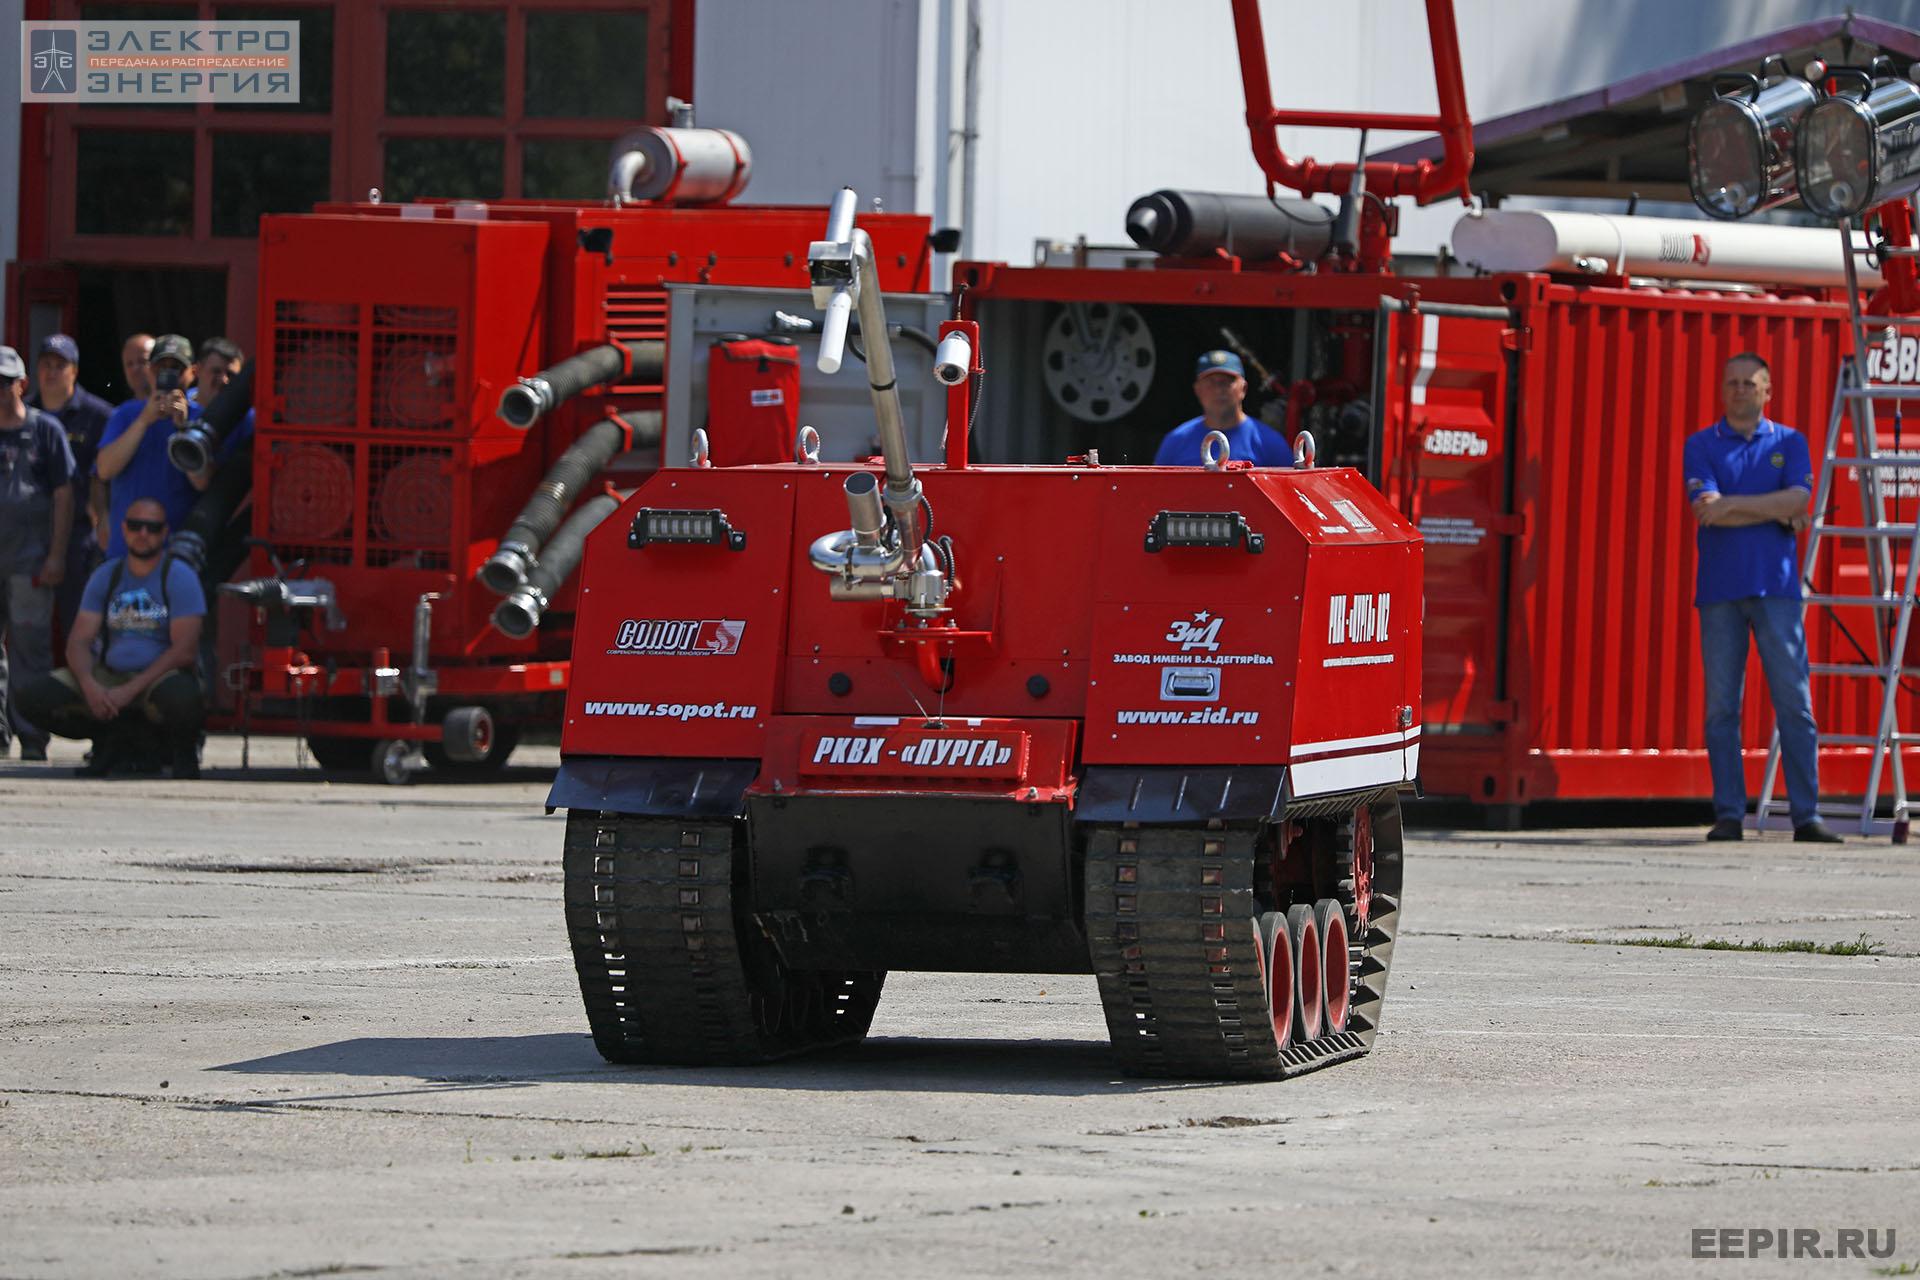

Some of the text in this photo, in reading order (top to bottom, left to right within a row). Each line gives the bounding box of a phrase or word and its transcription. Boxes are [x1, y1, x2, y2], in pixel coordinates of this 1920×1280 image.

[615, 619, 700, 650] СОПОТ
[1113, 654, 1151, 665] ЗАВОД
[1152, 655, 1192, 665] ИМЕНИ
[585, 701, 757, 721] www.sopot.ru
[1117, 706, 1259, 725] www.zid.ru
[813, 737, 886, 763] РКВХ
[901, 738, 1012, 767] «ПУРГА»
